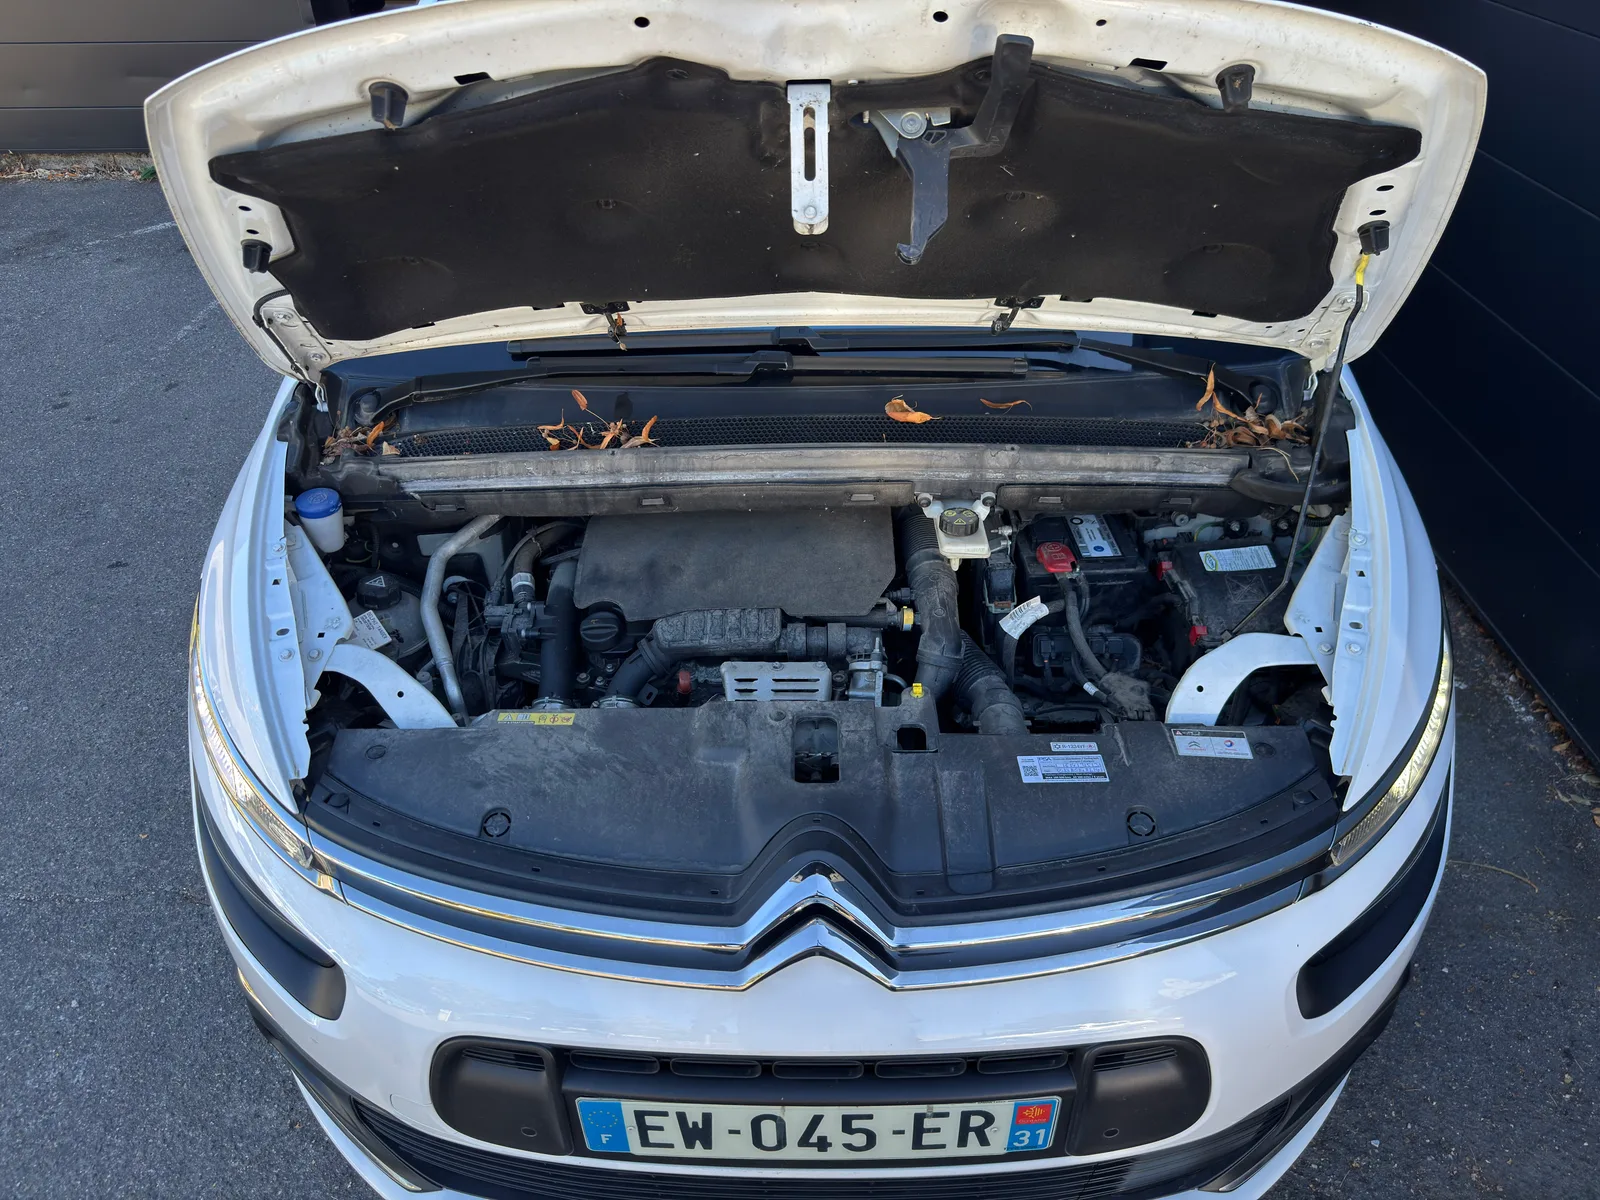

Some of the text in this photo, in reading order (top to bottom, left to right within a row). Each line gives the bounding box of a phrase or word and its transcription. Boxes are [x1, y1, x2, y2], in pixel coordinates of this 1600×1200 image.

[601, 1134, 612, 1144] F
[633, 1109, 996, 1151] EW-045-ER
[1012, 1128, 1046, 1147] 31
